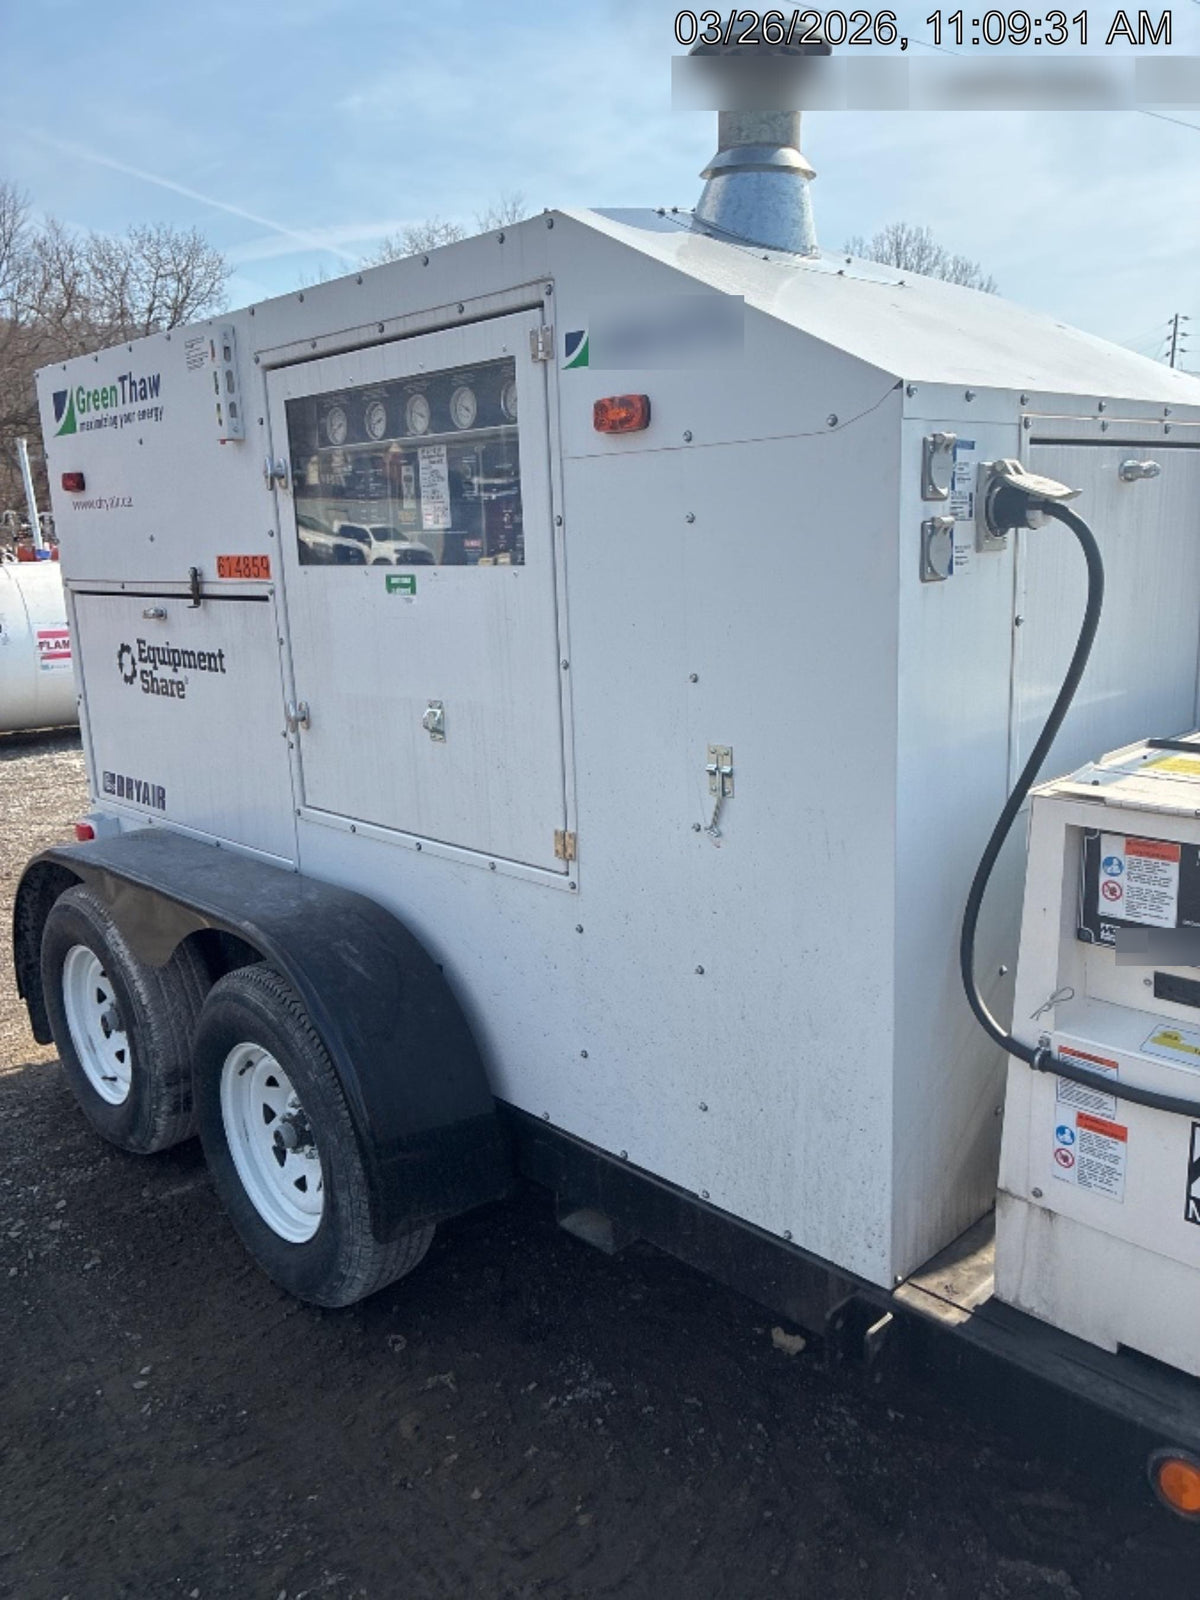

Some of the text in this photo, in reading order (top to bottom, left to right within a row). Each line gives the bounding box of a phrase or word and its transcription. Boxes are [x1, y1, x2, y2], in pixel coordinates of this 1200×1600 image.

[79, 405, 163, 432] maximizing your energy
[217, 556, 270, 579] 614859
[136, 638, 226, 674] Equipment
[140, 669, 186, 699] Share
[117, 774, 166, 811] DRYAIR
